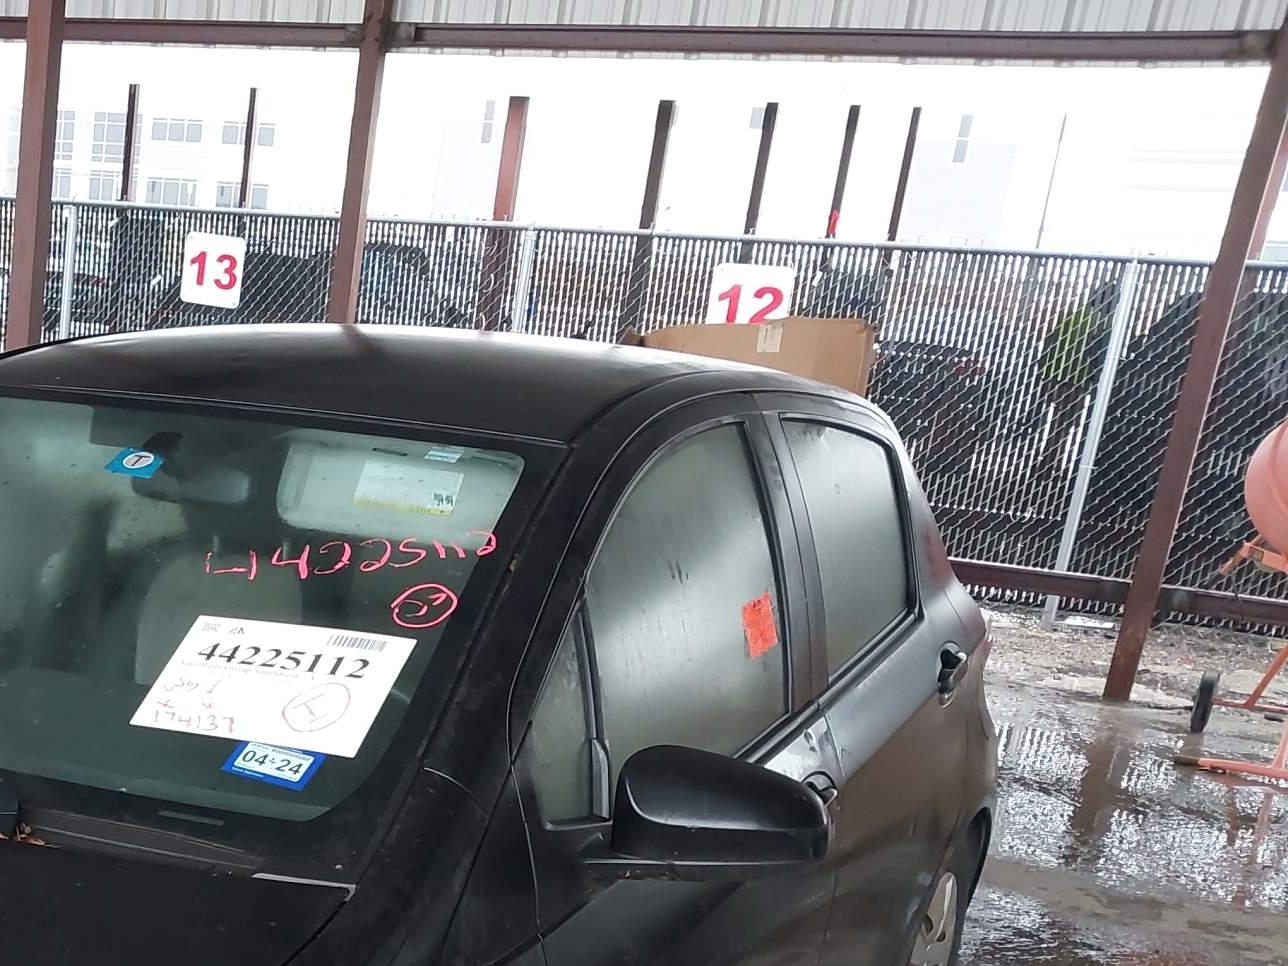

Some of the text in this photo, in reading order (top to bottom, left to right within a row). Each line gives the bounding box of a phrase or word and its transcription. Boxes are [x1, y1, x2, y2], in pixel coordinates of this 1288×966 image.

[190, 250, 238, 290] 13
[717, 284, 784, 324] 12
[205, 530, 497, 580] 44225112
[197, 642, 370, 679] 44225112
[242, 750, 269, 766] 04
[275, 759, 303, 775] 24
